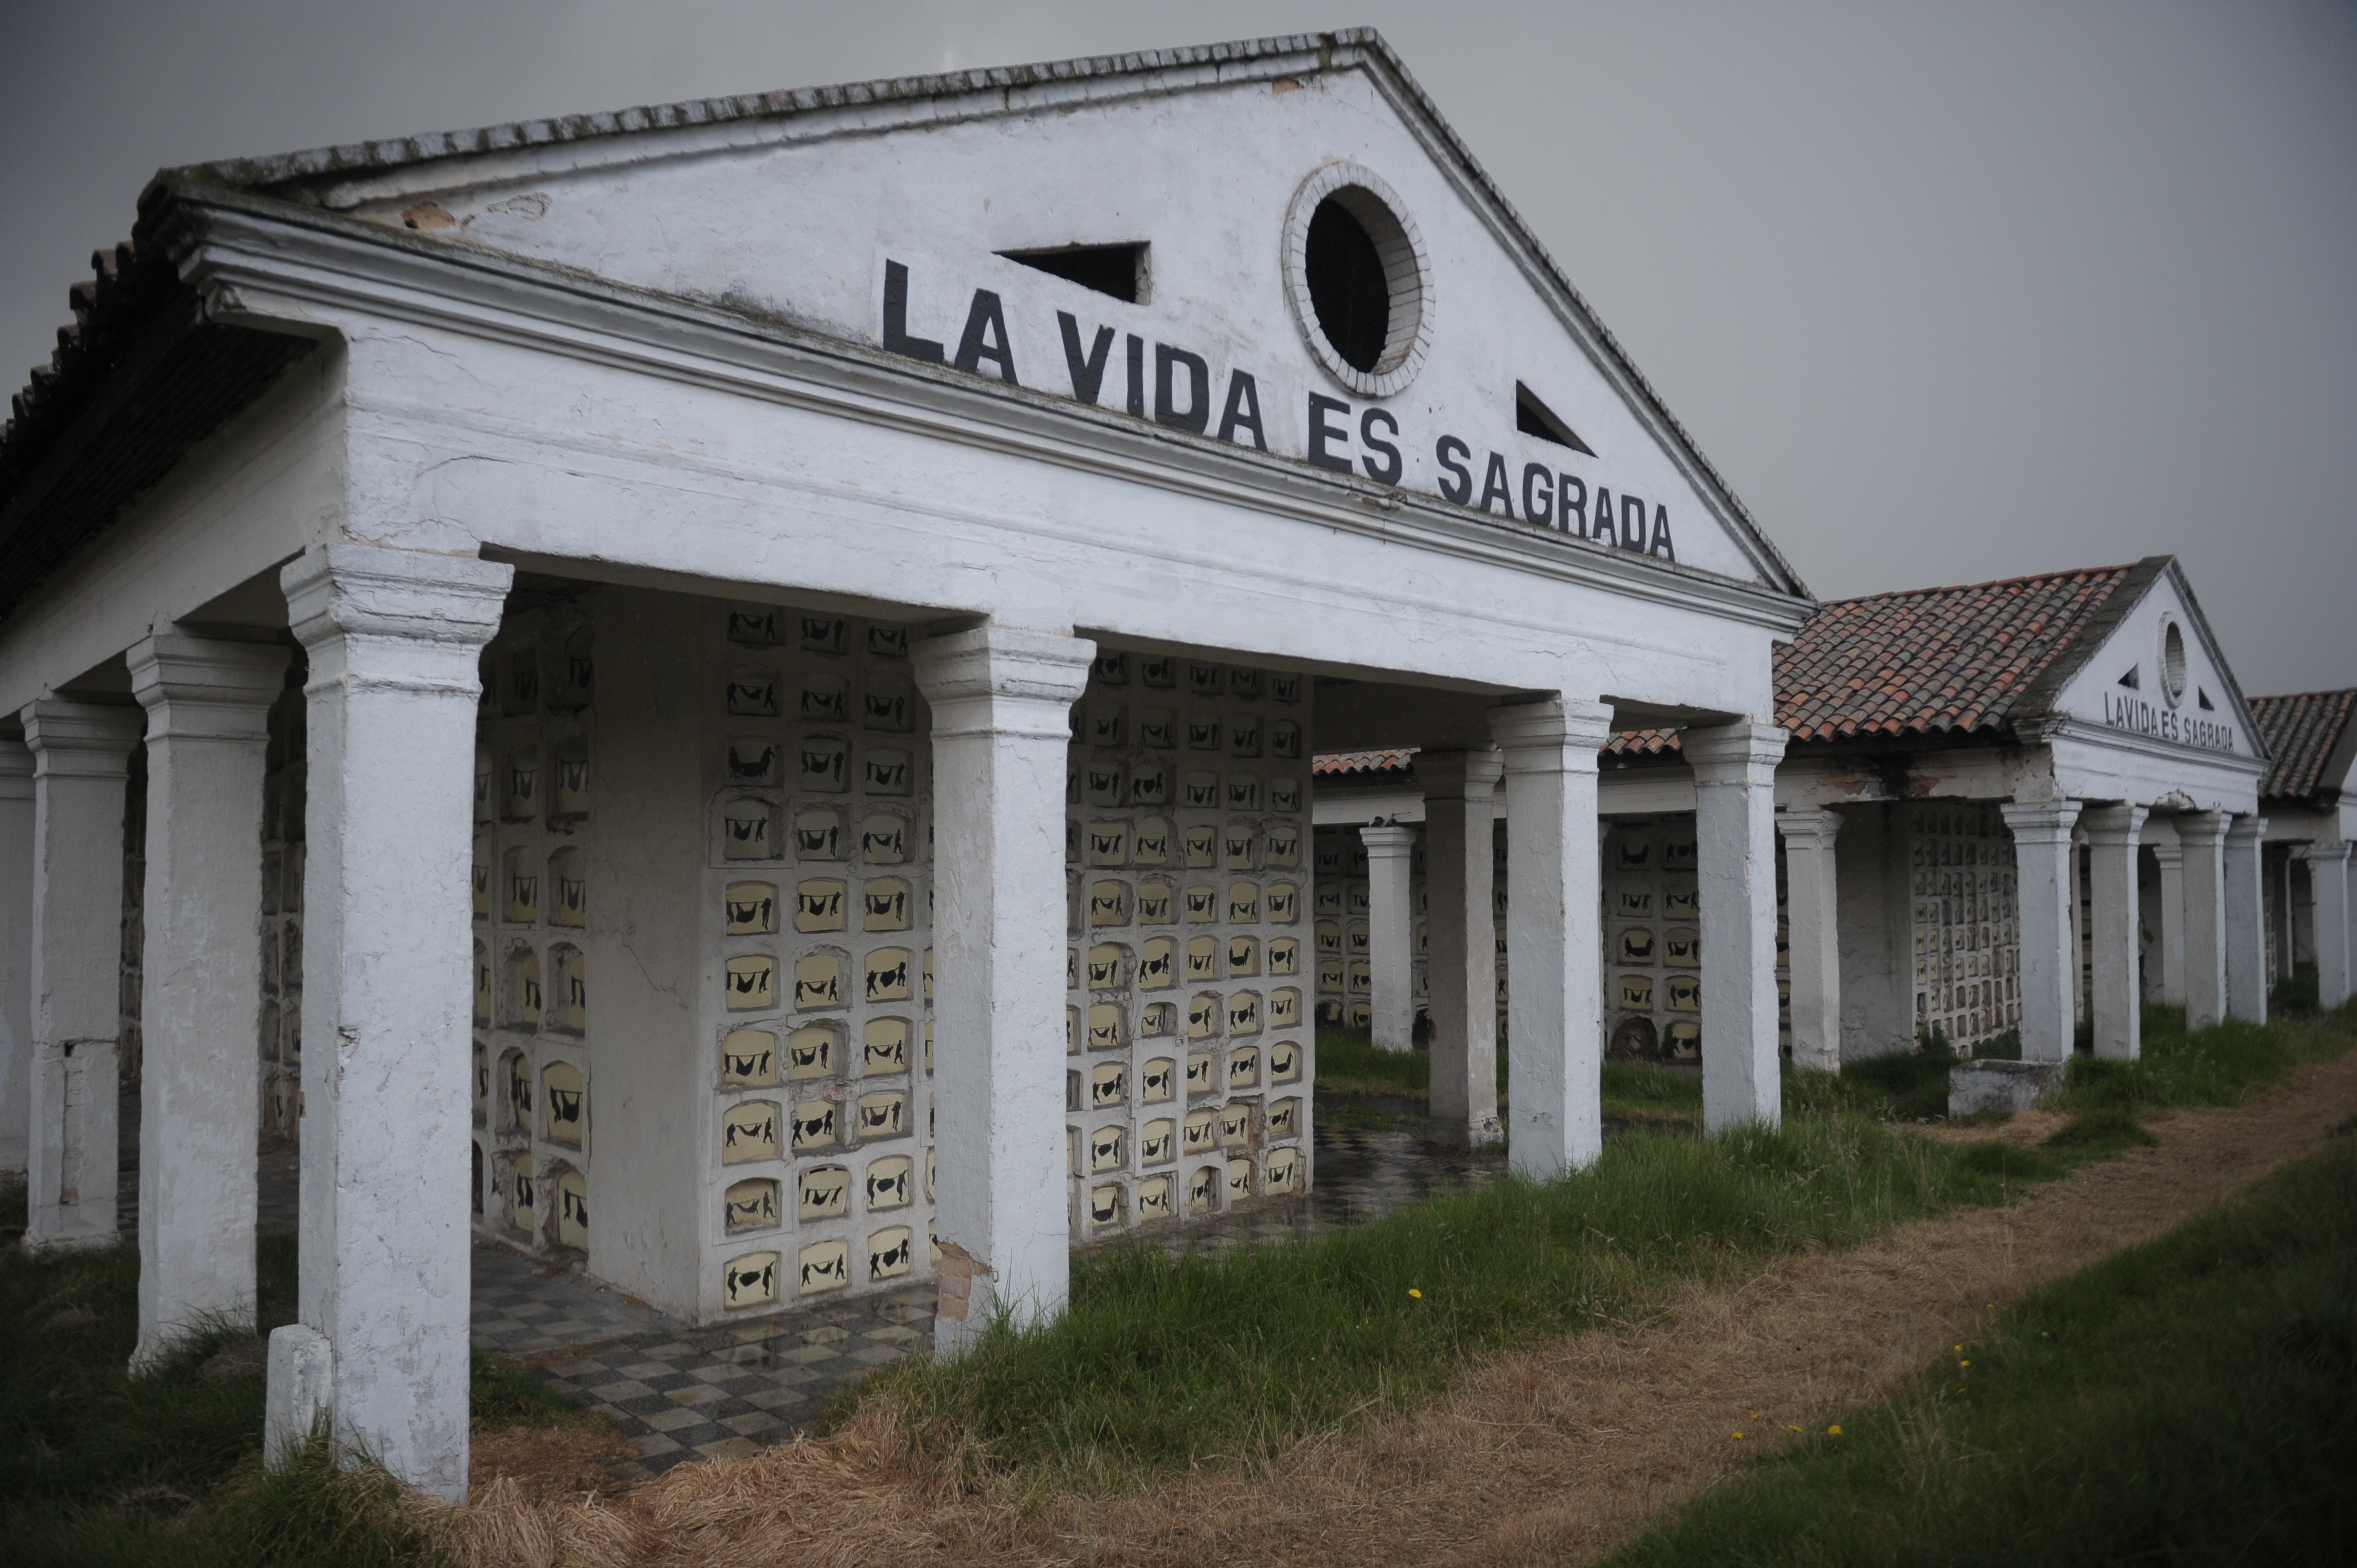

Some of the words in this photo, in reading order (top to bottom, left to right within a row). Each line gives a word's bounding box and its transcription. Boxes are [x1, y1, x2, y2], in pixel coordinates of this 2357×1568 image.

[883, 257, 1019, 386] LA
[1056, 309, 1269, 452] VIDA
[1308, 390, 1403, 487] ES
[1437, 435, 1676, 561] SAGRADA
[2104, 691, 2124, 728] LA
[2124, 695, 2158, 735] VIDA
[2162, 710, 2179, 741] ES
[2184, 717, 2234, 752] SAGRADA
